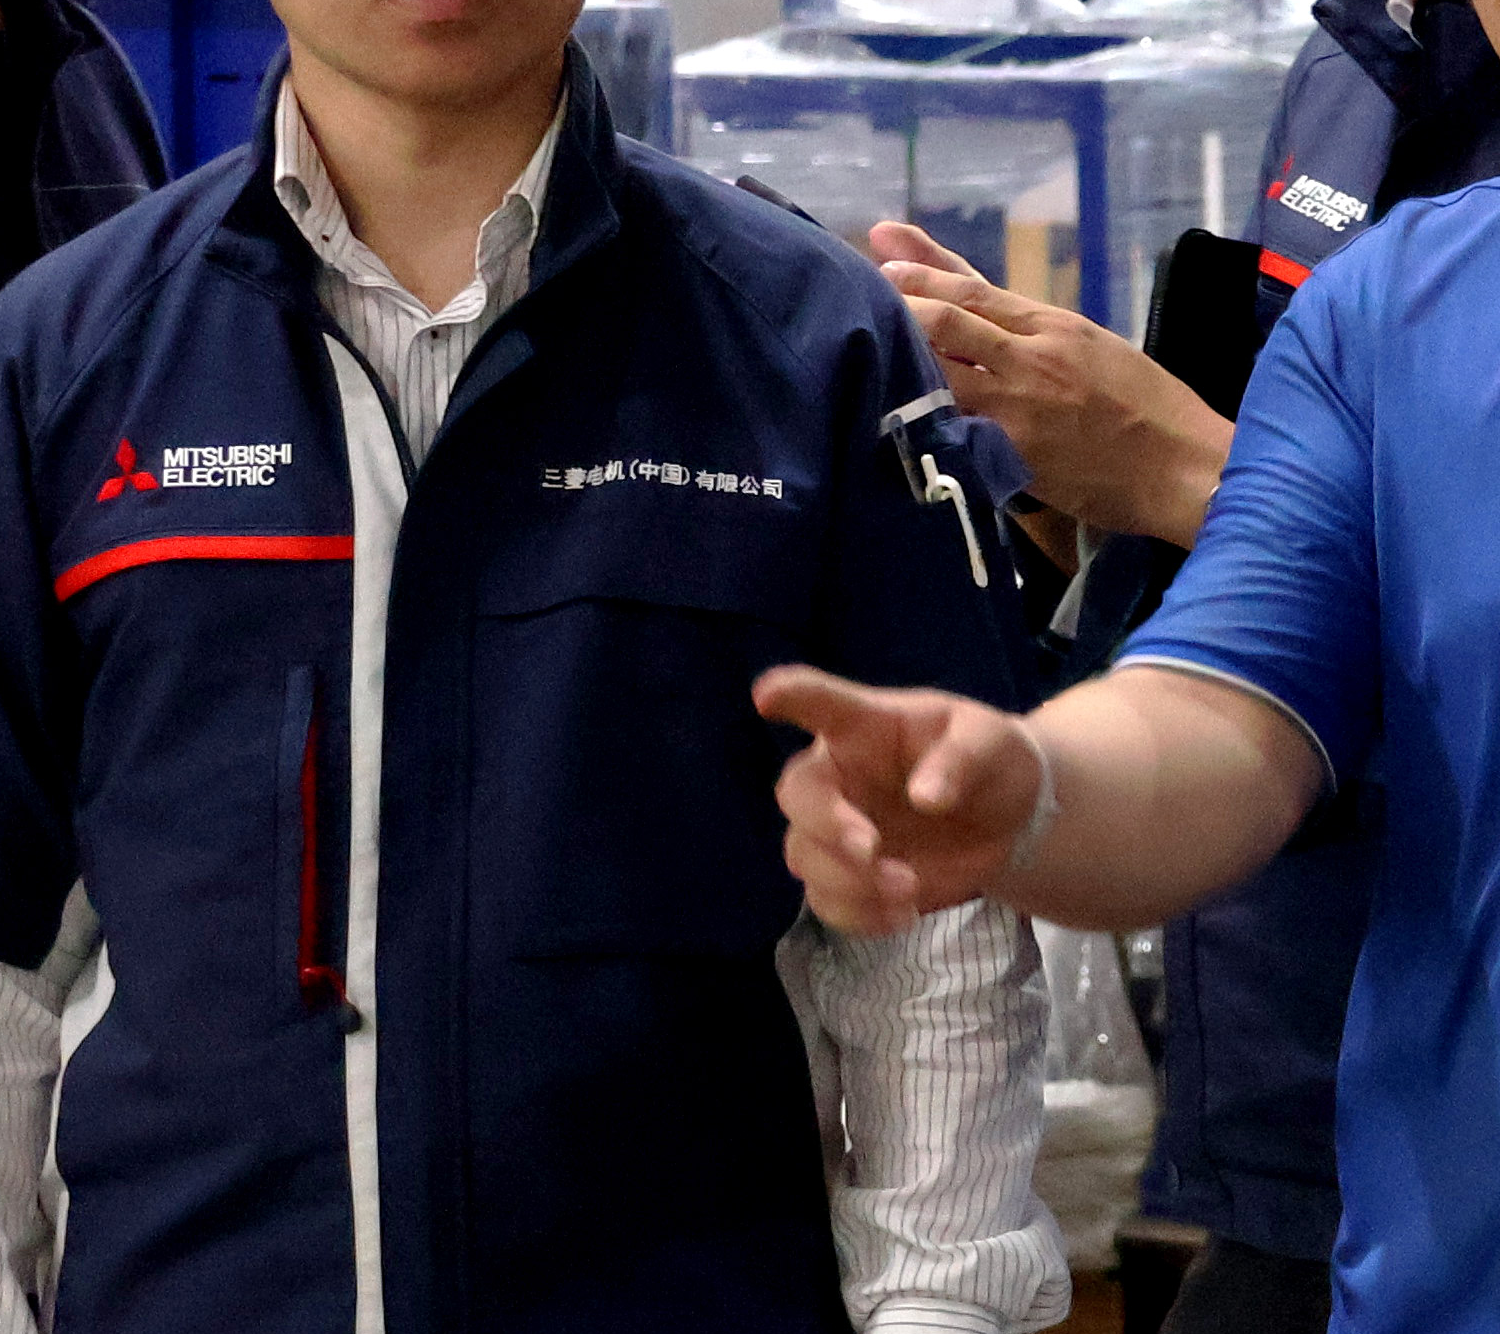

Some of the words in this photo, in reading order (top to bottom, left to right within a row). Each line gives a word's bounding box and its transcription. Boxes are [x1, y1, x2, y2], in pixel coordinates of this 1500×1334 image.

[1279, 188, 1351, 232] ELECTRIC
[1291, 174, 1369, 222] MITSUBISHI
[162, 442, 293, 468] MITSUBISHI
[161, 465, 276, 489] ELECTRIC
